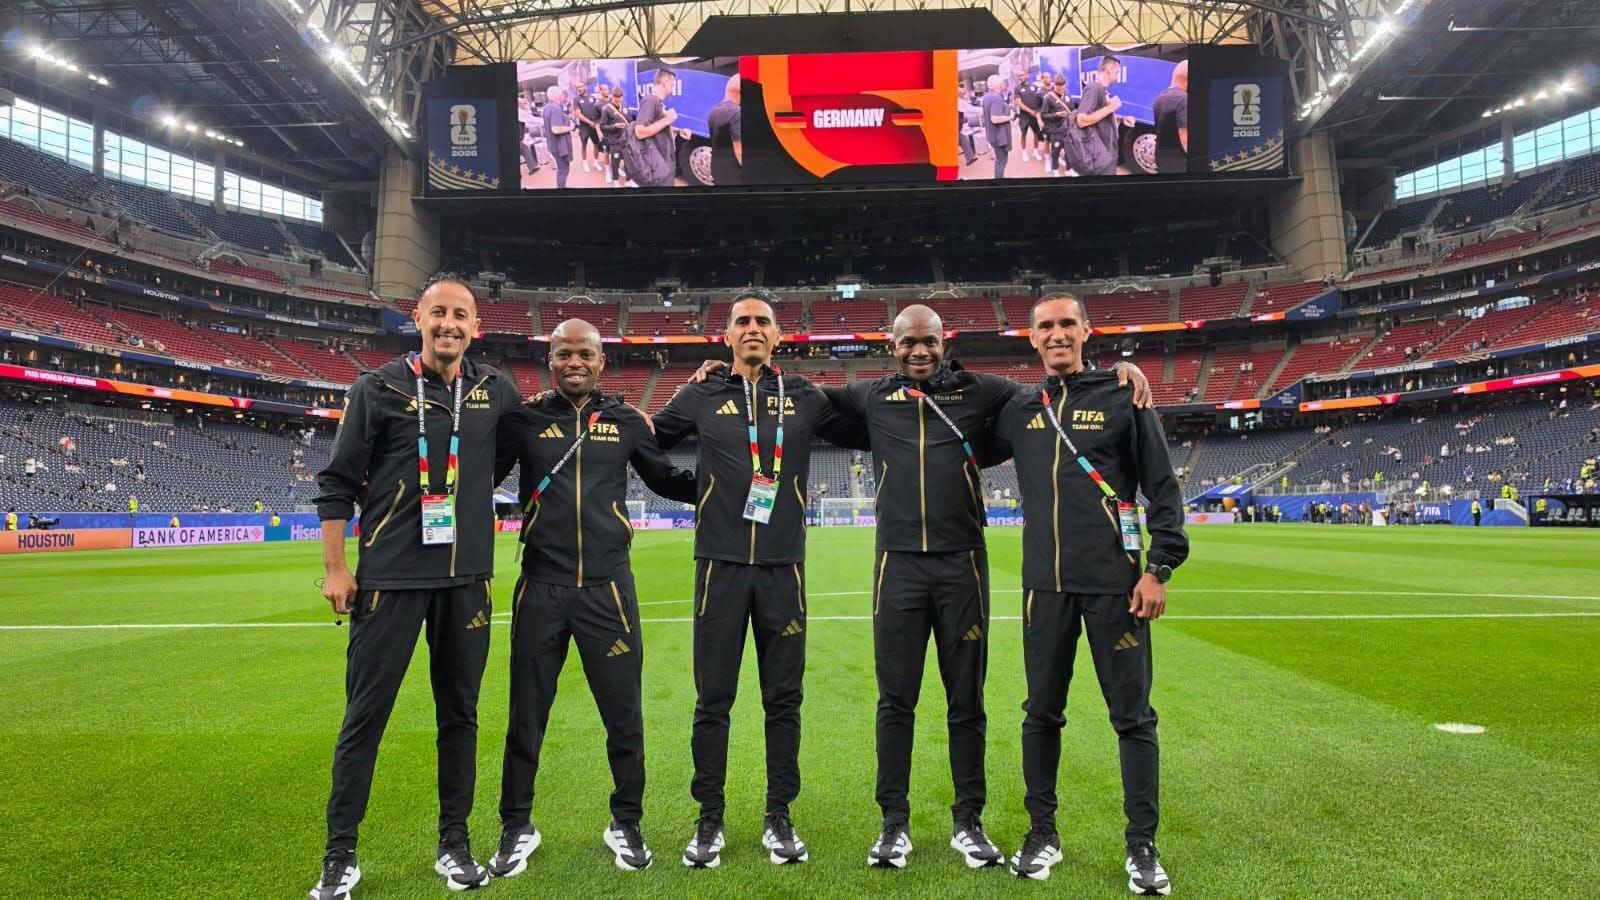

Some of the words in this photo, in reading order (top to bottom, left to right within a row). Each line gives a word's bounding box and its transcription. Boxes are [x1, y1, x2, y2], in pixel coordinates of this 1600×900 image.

[813, 108, 884, 128] GERMANY
[143, 288, 180, 301] HOUSTON
[1544, 335, 1588, 350] HOUSTON
[174, 359, 212, 371] HOUSTON
[468, 390, 489, 401] IFA
[768, 397, 795, 408] FIA
[1072, 410, 1105, 422] FIFA
[589, 423, 619, 435] FIFA
[1424, 506, 1441, 516] FIFA
[138, 530, 175, 545] BANK
[179, 529, 196, 543] OF
[199, 528, 250, 541] AMERICA
[290, 524, 324, 540] Hisen
[18, 533, 75, 549] HOUSTON
